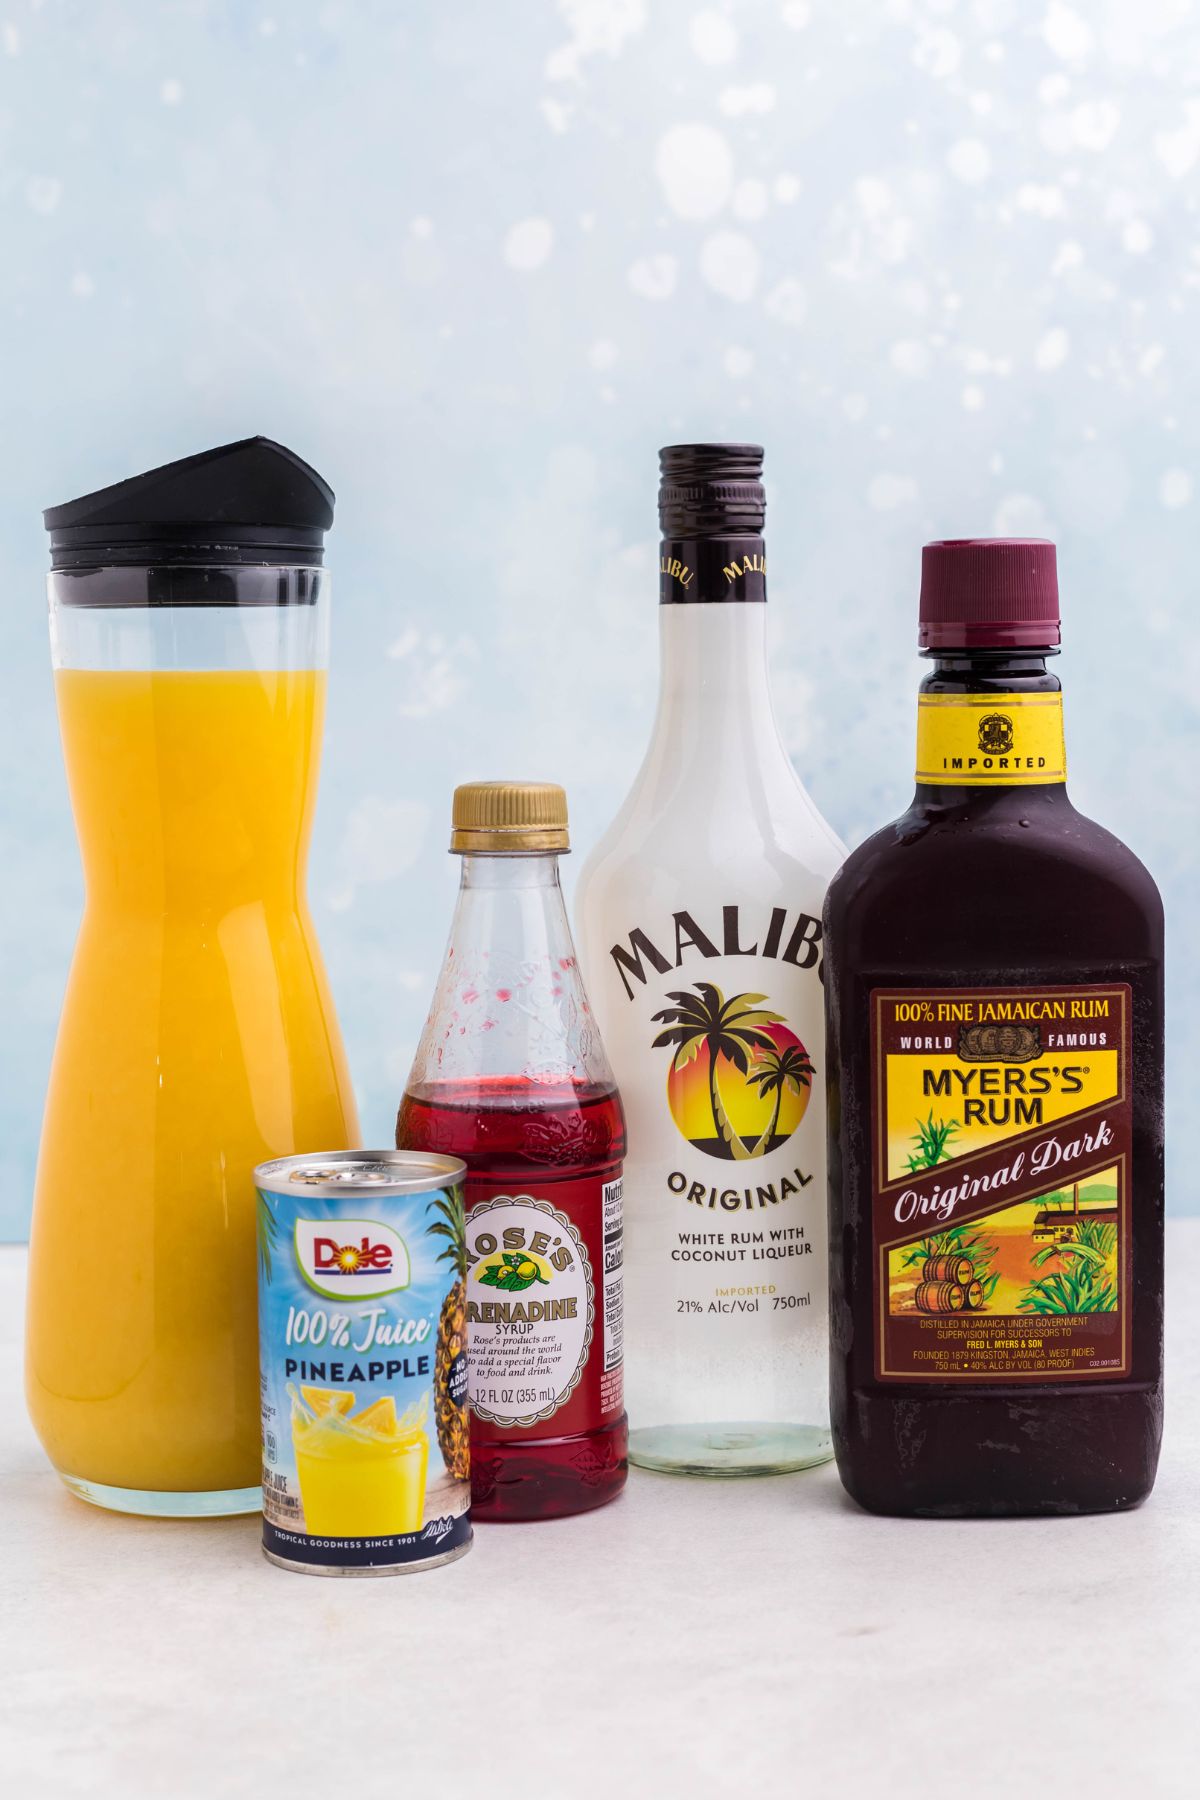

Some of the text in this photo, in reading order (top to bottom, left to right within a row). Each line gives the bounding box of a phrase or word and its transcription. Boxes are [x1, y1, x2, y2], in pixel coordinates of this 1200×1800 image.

[660, 556, 694, 585] LIBU
[723, 554, 767, 584] MALI
[943, 756, 1046, 769] IMPORTED
[610, 905, 824, 1002] MALIB
[895, 1000, 1110, 1023] 100% FINE JAMAICAN RUM
[901, 1032, 1108, 1049] WORLD FAMOUS
[964, 1097, 1043, 1126] RUM
[894, 1120, 1115, 1223] Original Dark
[667, 1168, 814, 1211] ORIGINAL
[678, 1227, 804, 1245] WHITE RUM WITH
[314, 1237, 393, 1272] Dole
[671, 1243, 813, 1262] COCONUT LIQUEUR
[715, 1285, 777, 1297] IMPORTED
[466, 1297, 578, 1324] RENADINE
[677, 1293, 811, 1314] 21% Alc/Vol 750ml
[285, 1306, 433, 1352] 100% Juice
[495, 1324, 534, 1335] SYRUP
[920, 1317, 1089, 1329] DISTILLED IN JAMAICA UNDER GOVERNMENT
[473, 1335, 556, 1347] Rose's products are
[937, 1328, 1072, 1339] SUPERVISION FOR SUCCESSORS TO
[467, 1343, 562, 1356] used around the world
[966, 1341, 985, 1349] FRED
[994, 1340, 1019, 1349] MYERS
[1020, 1340, 1026, 1349] &
[1027, 1339, 1043, 1348] SON
[467, 1357, 476, 1366] to
[477, 1357, 495, 1366] add
[504, 1356, 535, 1368] special
[535, 1355, 562, 1368] flavor
[913, 1351, 949, 1360] FOUNDED
[951, 1351, 969, 1360] 1879
[1049, 1348, 1069, 1358] WEST
[1071, 1347, 1095, 1357] INDIES
[285, 1355, 430, 1382] PINEAPPLE
[476, 1366, 553, 1380] to food and drink.
[935, 1358, 1075, 1370] 750 mL 40% ALC BY VOL (80 PROOF)
[475, 1387, 556, 1404] 12 FL OZ (355 mL)
[274, 1530, 417, 1549] TROPICAL GOODNESS SINCE 1901
